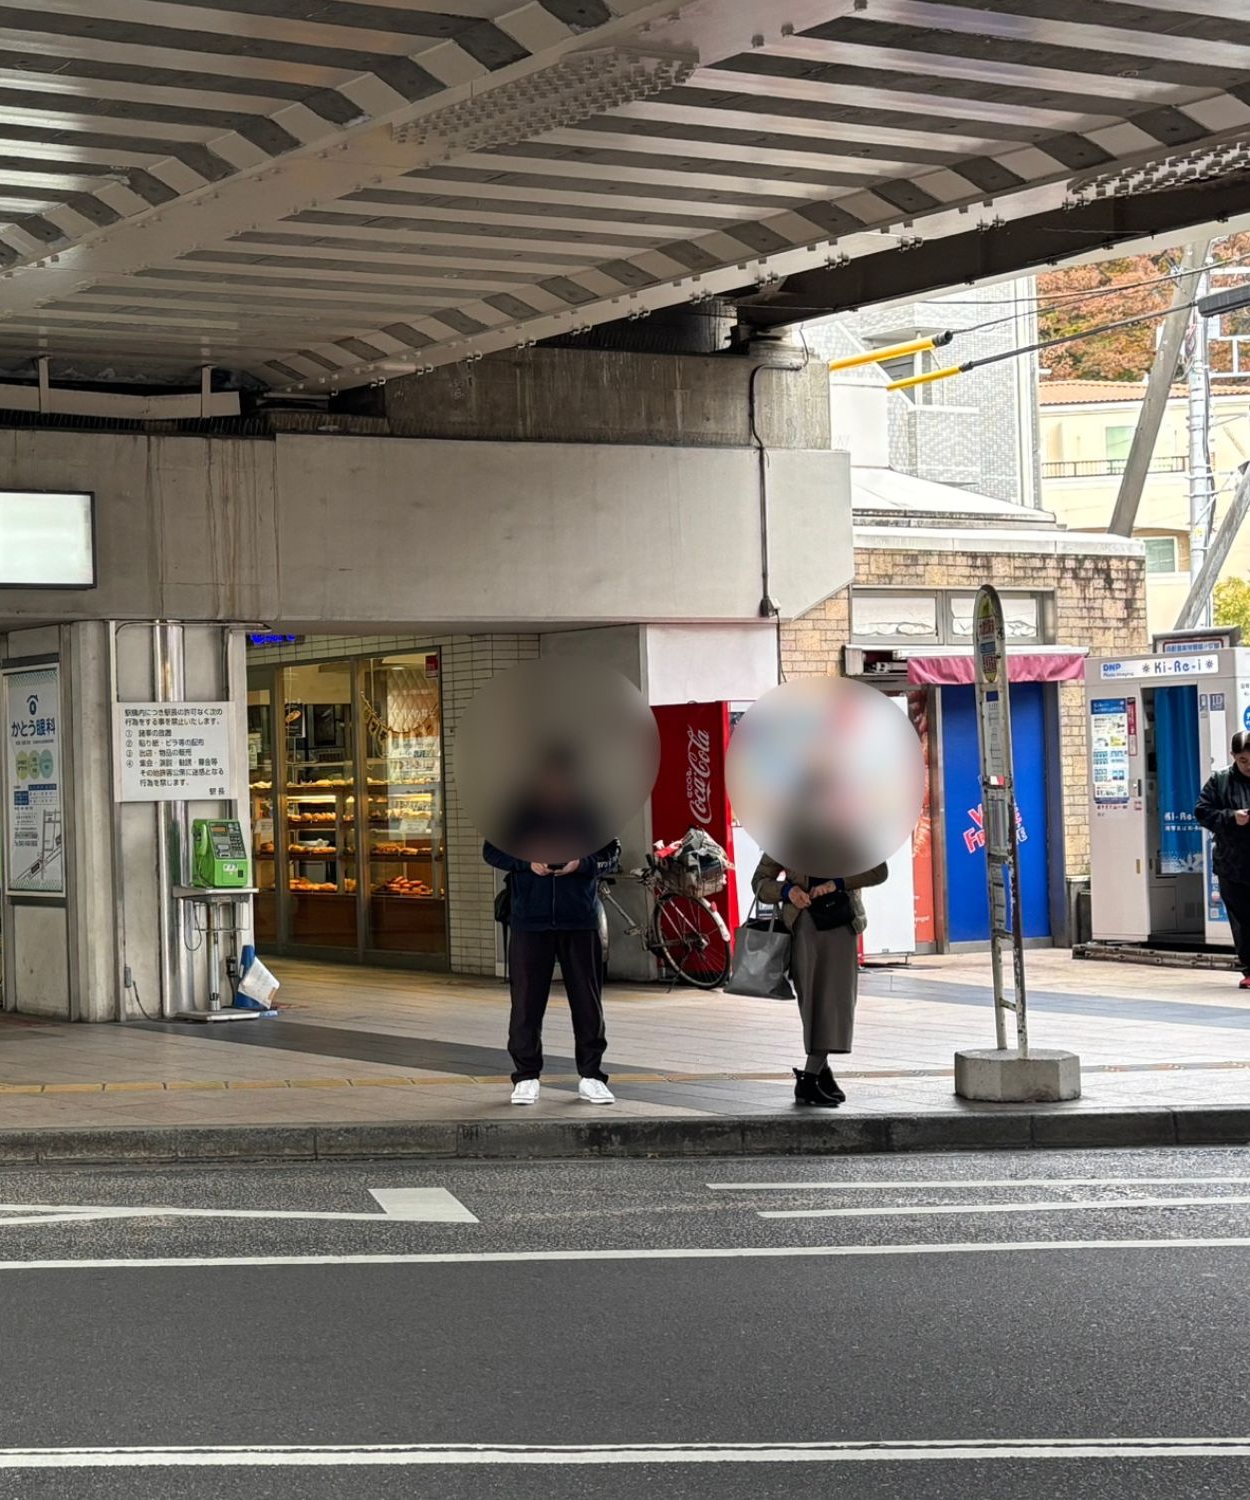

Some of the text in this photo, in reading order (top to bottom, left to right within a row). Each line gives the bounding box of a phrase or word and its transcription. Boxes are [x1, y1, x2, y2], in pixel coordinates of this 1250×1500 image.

[1102, 663, 1122, 672] DNP
[10, 717, 57, 739] かとう眼科
[1164, 811, 1197, 821] Ki-Re-
